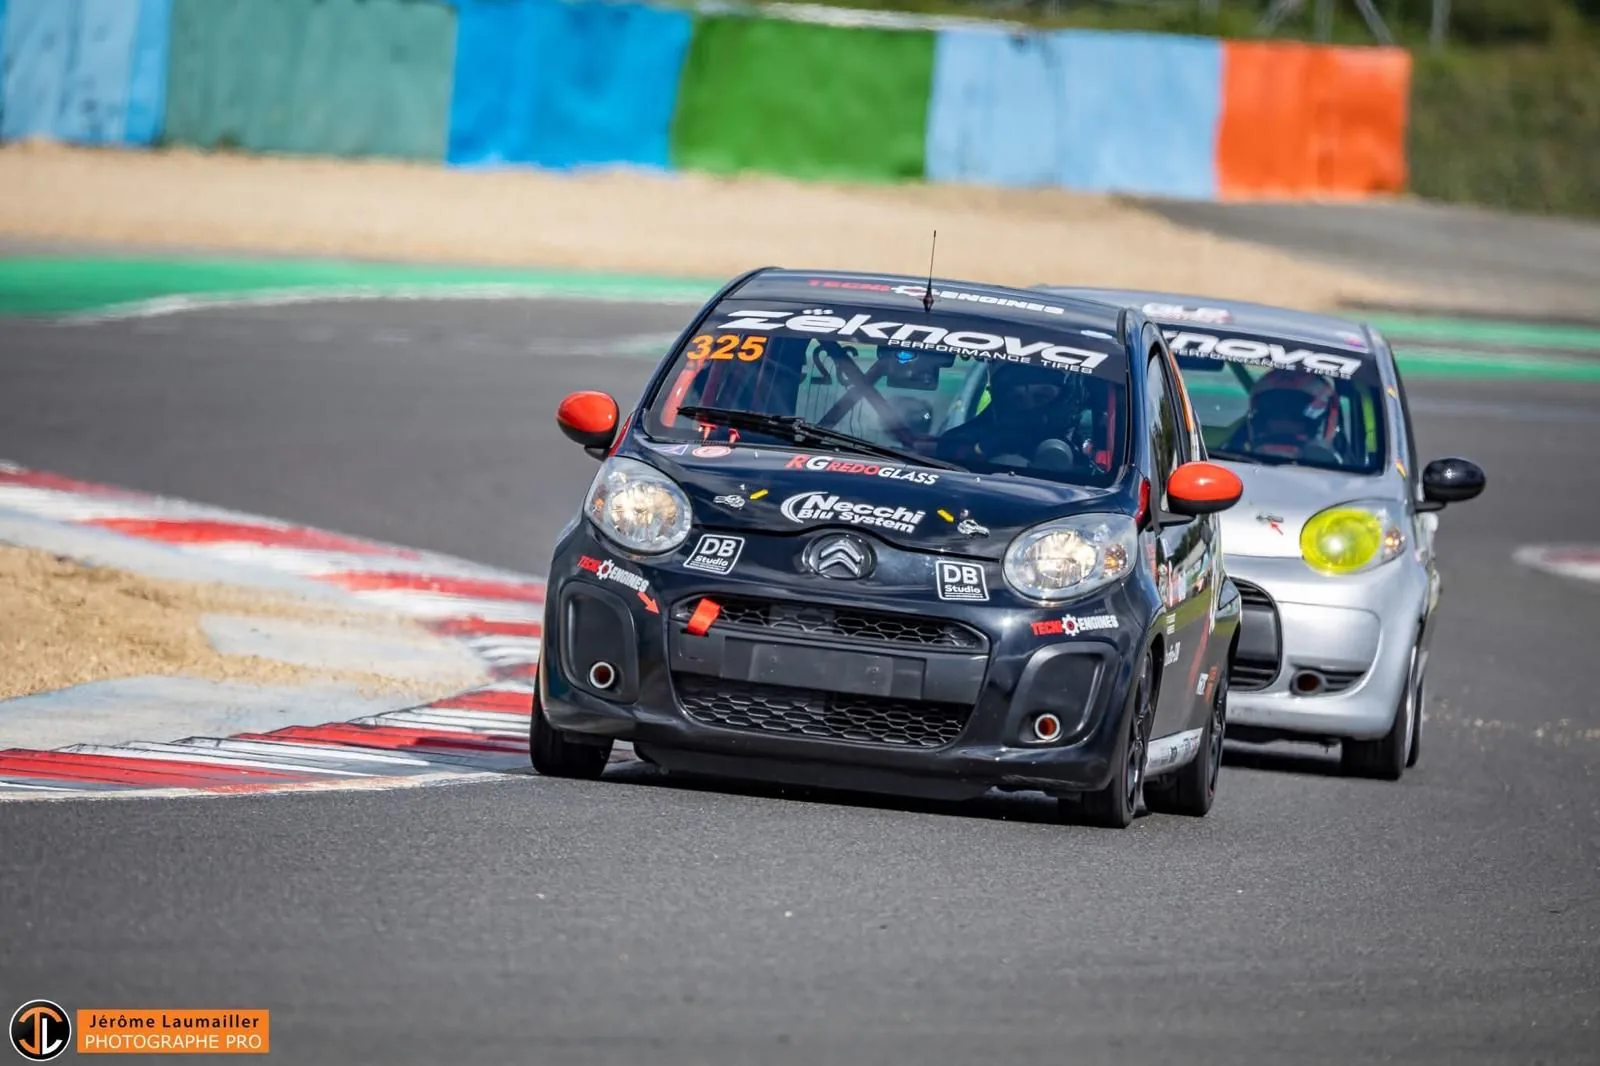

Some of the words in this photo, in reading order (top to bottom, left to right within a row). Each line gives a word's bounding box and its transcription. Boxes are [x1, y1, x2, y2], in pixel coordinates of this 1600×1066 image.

[687, 335, 767, 361] 325
[888, 339, 1031, 364] PERFORMANCE
[1041, 359, 1093, 374] TIRES
[1162, 330, 1362, 376] nova
[797, 509, 834, 521] Blu
[839, 510, 918, 534] System
[802, 494, 926, 525] Necchi
[700, 538, 737, 557] DB
[694, 555, 729, 567] Studio
[943, 564, 979, 585] DB
[945, 585, 981, 594] Studio
